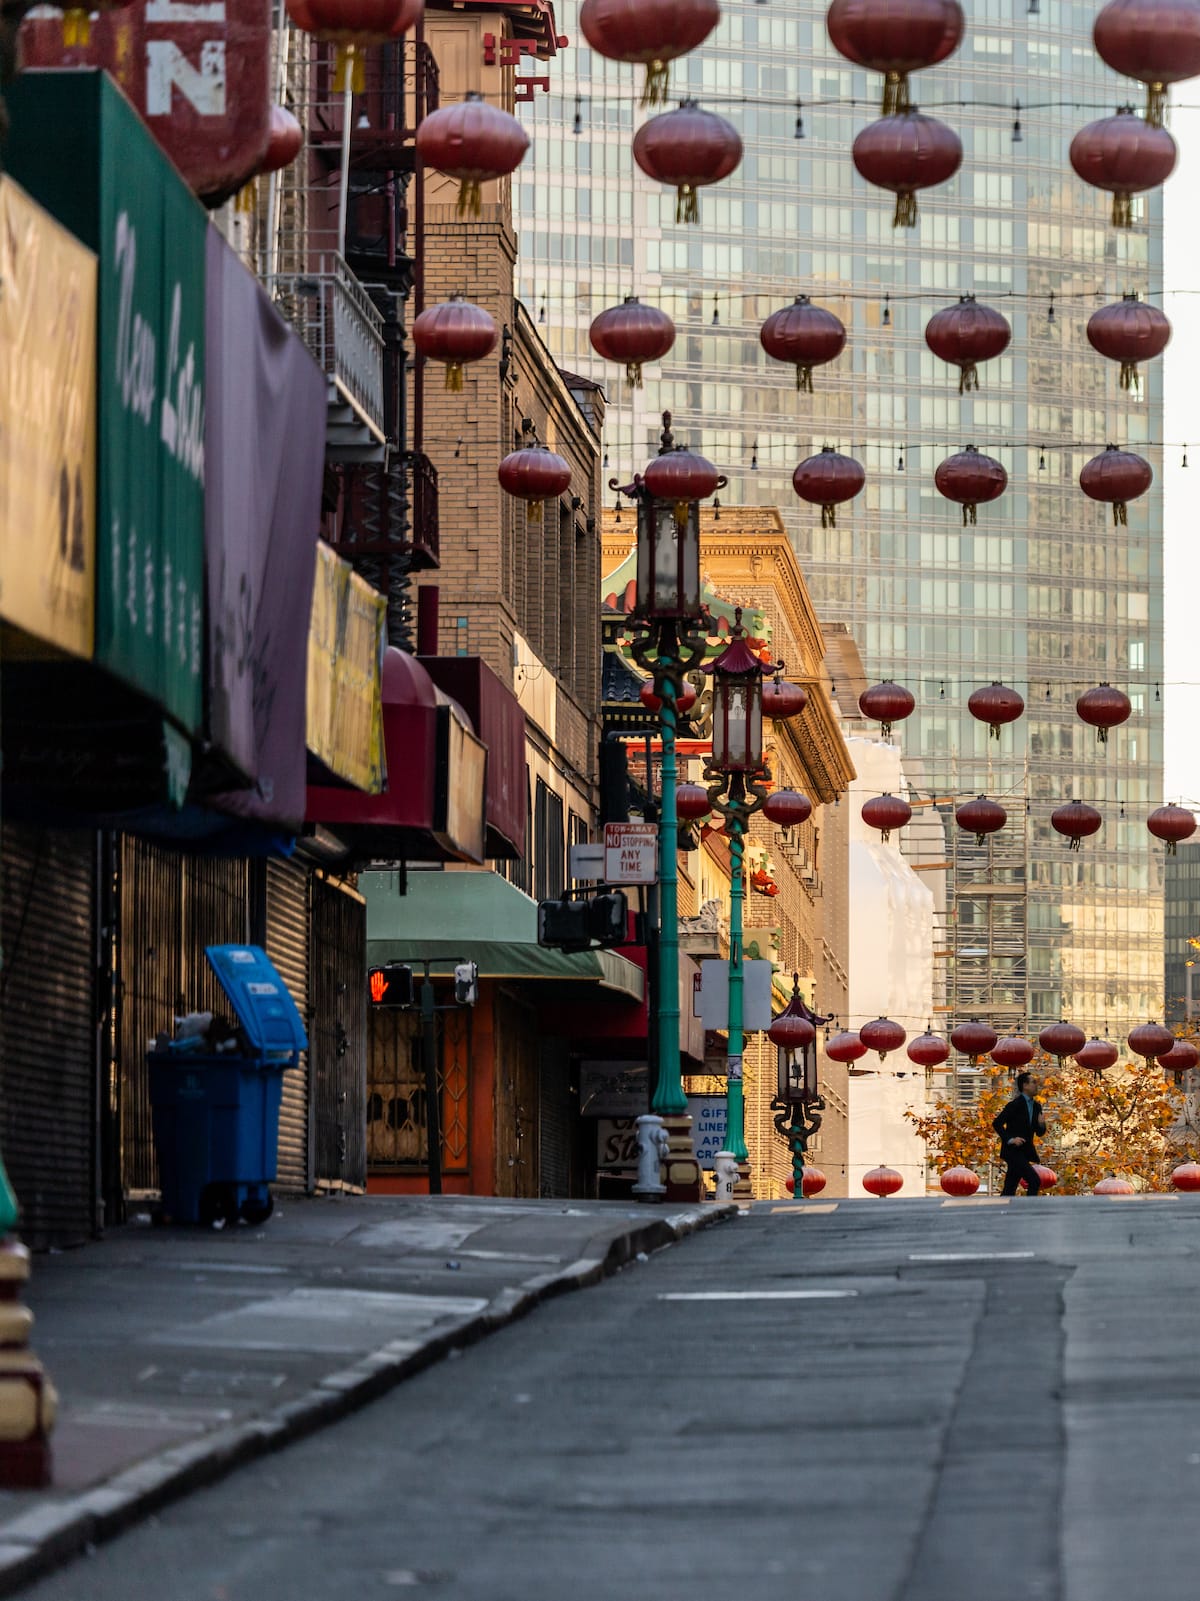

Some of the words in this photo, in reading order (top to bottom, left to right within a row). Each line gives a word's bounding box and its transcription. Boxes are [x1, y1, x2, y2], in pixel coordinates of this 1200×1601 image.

[606, 834, 620, 847] NO
[622, 836, 655, 847] STOPPING
[621, 850, 641, 860] ANY
[620, 862, 642, 873] TIME
